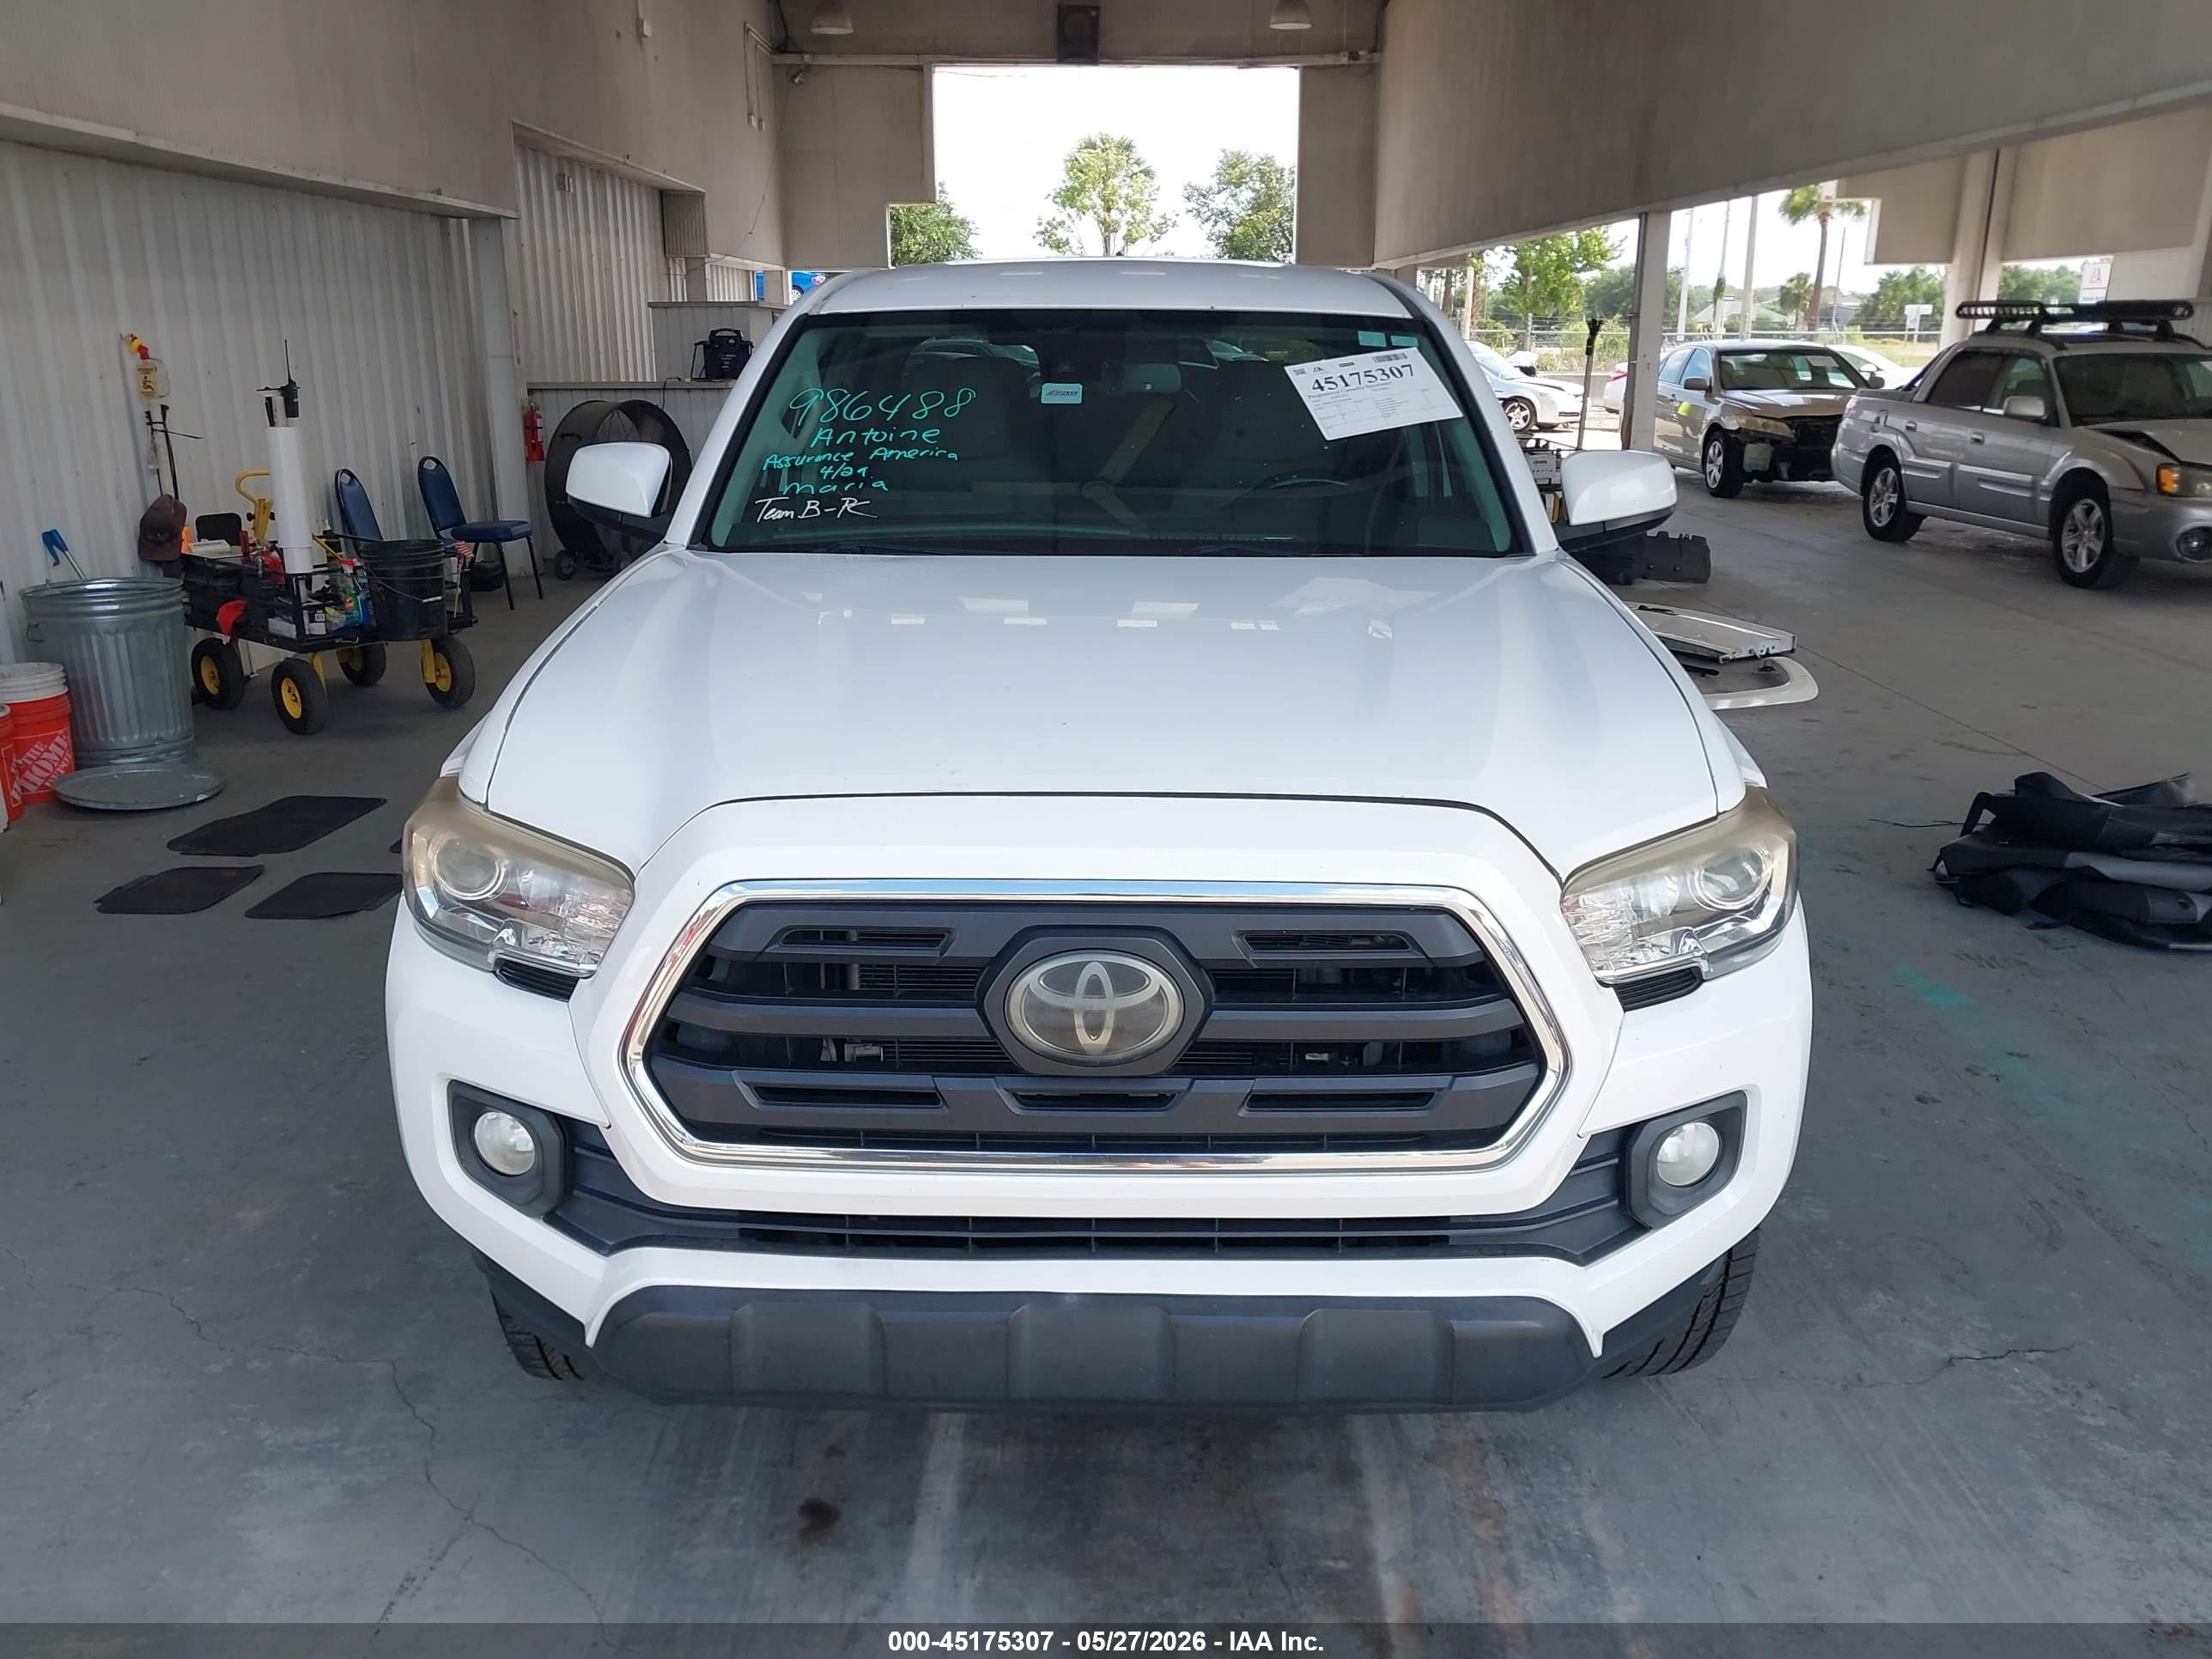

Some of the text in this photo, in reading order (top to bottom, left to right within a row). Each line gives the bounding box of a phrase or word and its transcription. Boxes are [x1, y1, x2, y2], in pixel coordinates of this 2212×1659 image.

[1311, 364, 1414, 392] 45175307
[789, 387, 976, 427] 986488
[810, 427, 940, 447] Antoine
[20, 732, 70, 791] HOME
